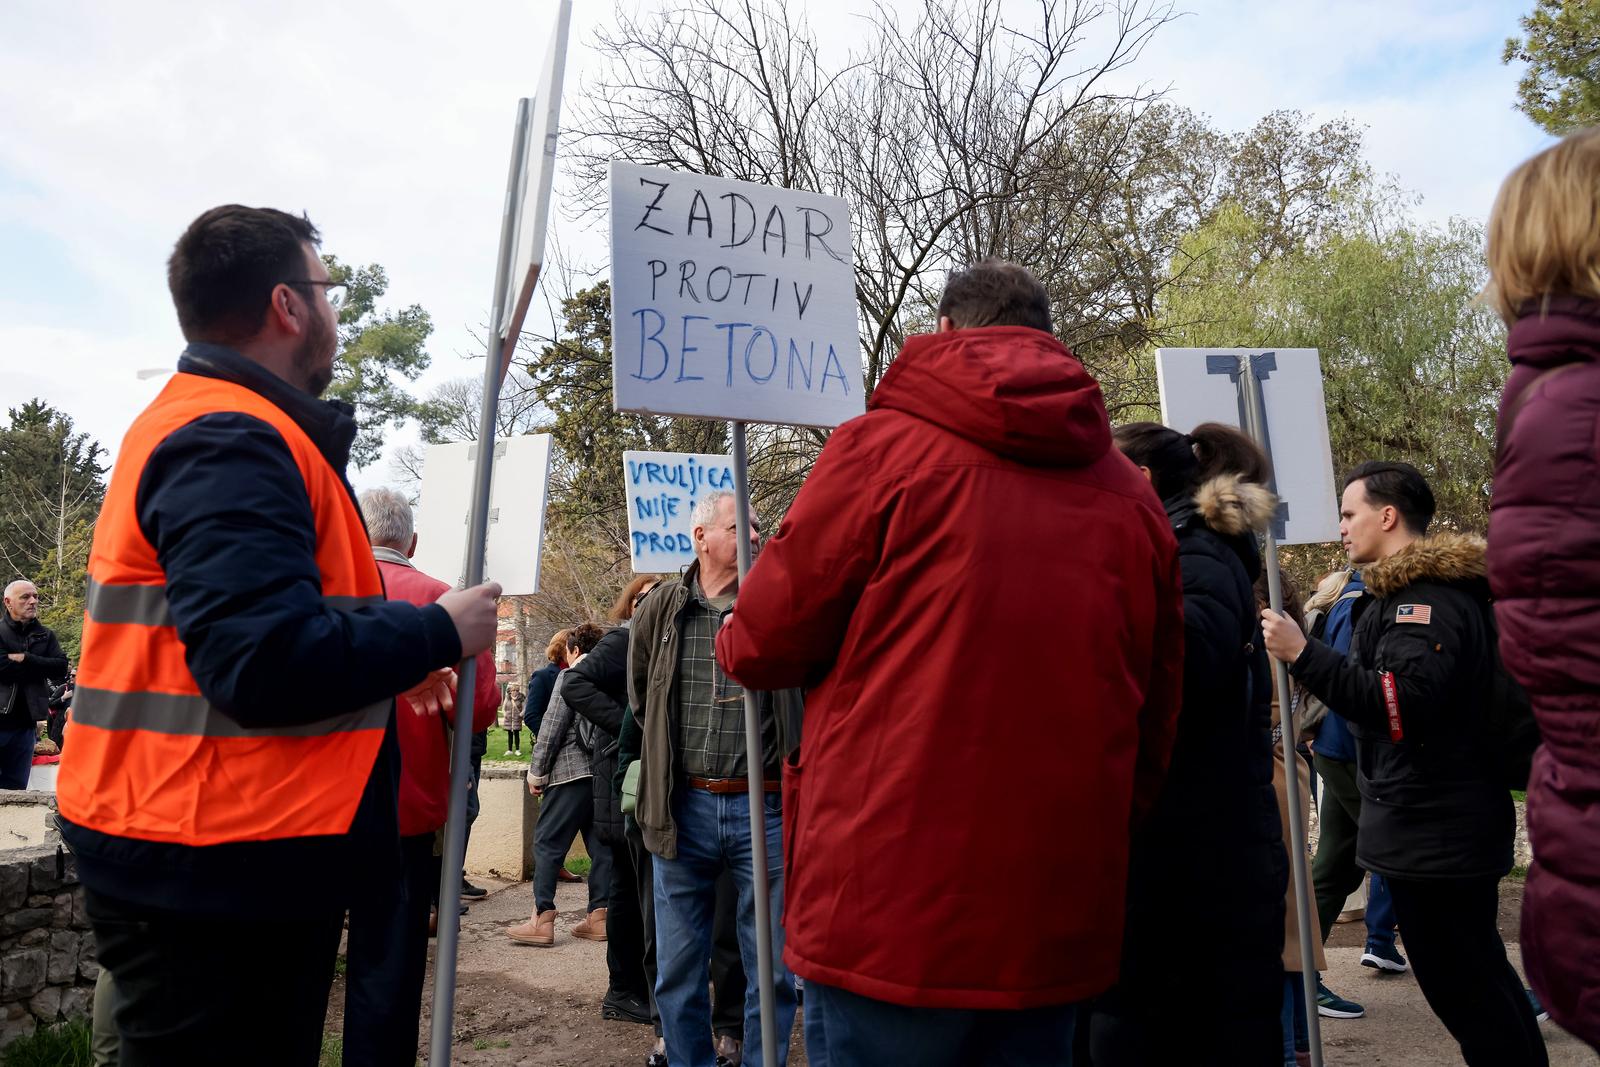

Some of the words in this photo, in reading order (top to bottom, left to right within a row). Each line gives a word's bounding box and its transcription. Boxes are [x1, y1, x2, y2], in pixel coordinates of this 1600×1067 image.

[634, 177, 848, 265] ZADAR
[648, 259, 813, 320] PROTIV
[630, 308, 850, 396] BETONA
[631, 531, 692, 557] PROD
